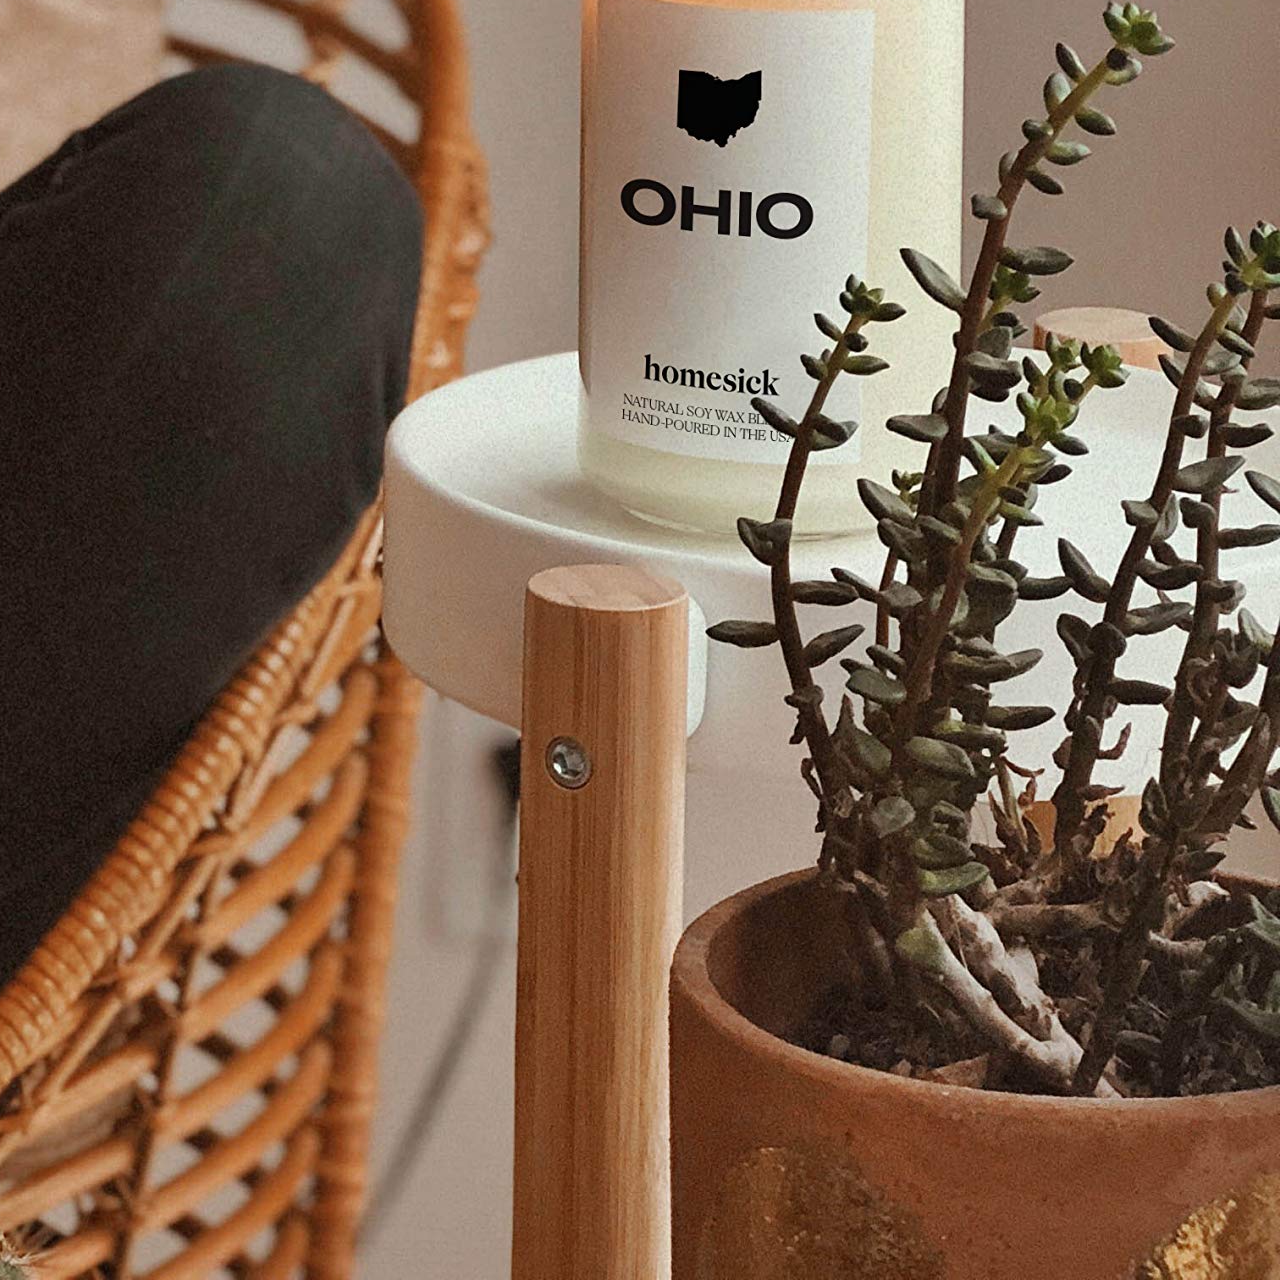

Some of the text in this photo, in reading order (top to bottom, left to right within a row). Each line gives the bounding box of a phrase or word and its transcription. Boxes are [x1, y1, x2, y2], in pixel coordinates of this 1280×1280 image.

[620, 178, 813, 239] OHIO
[644, 353, 780, 396] homesick
[621, 408, 720, 437] HAND-POURED
[723, 426, 737, 439] IN
[740, 427, 766, 441] THE
[623, 393, 684, 415] NATURAL
[686, 405, 712, 421] SOY
[715, 409, 745, 424] WAX
